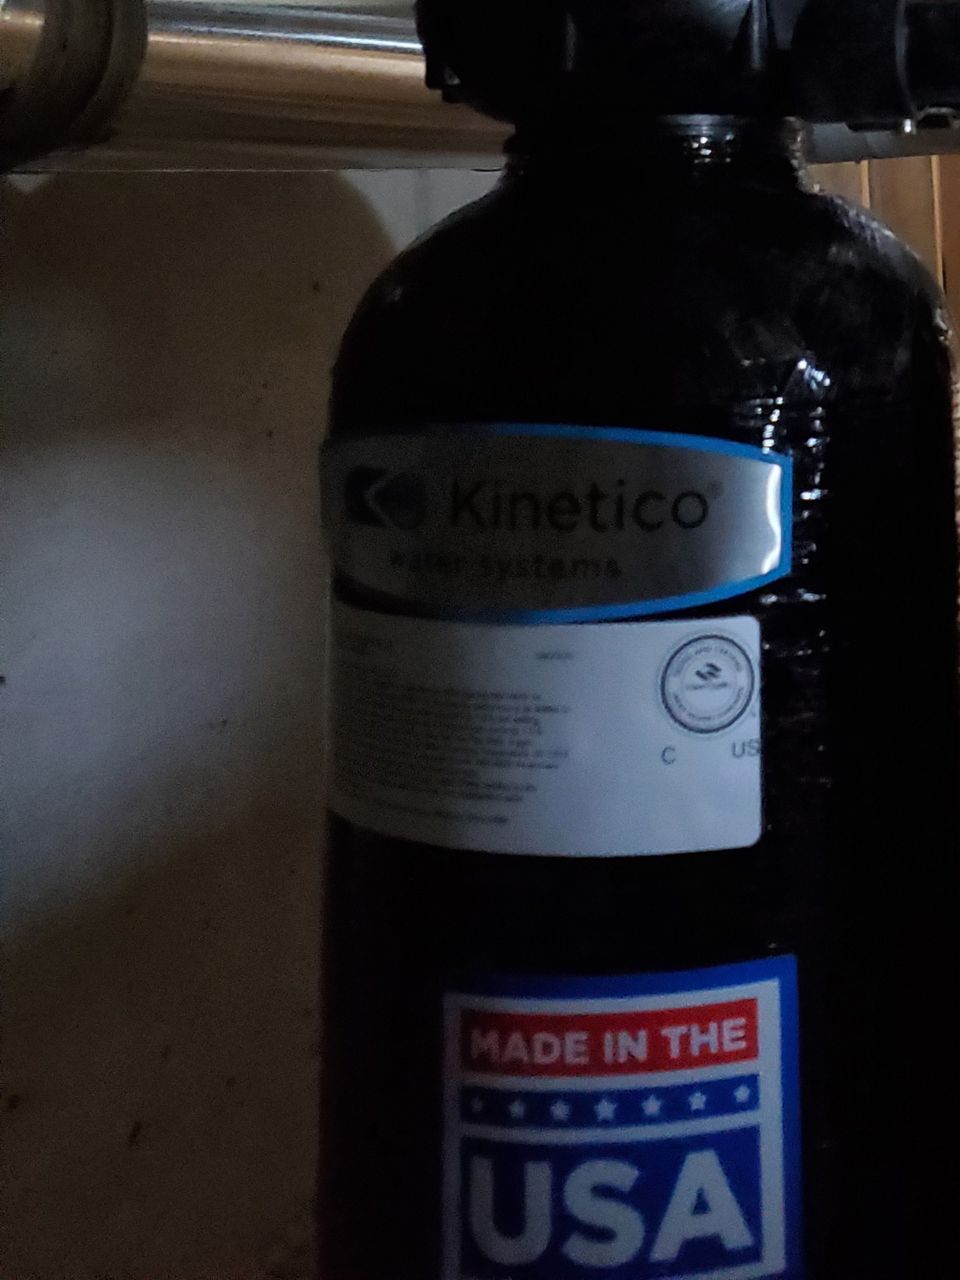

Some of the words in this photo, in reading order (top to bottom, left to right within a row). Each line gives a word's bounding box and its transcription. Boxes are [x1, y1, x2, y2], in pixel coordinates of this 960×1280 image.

[450, 478, 709, 533] Kinetico
[480, 552, 622, 580] systems
[661, 746, 677, 766] C
[470, 1029, 590, 1065] MADE
[603, 1030, 648, 1064] IN
[661, 1018, 747, 1059] THE
[470, 1149, 754, 1267] USA
